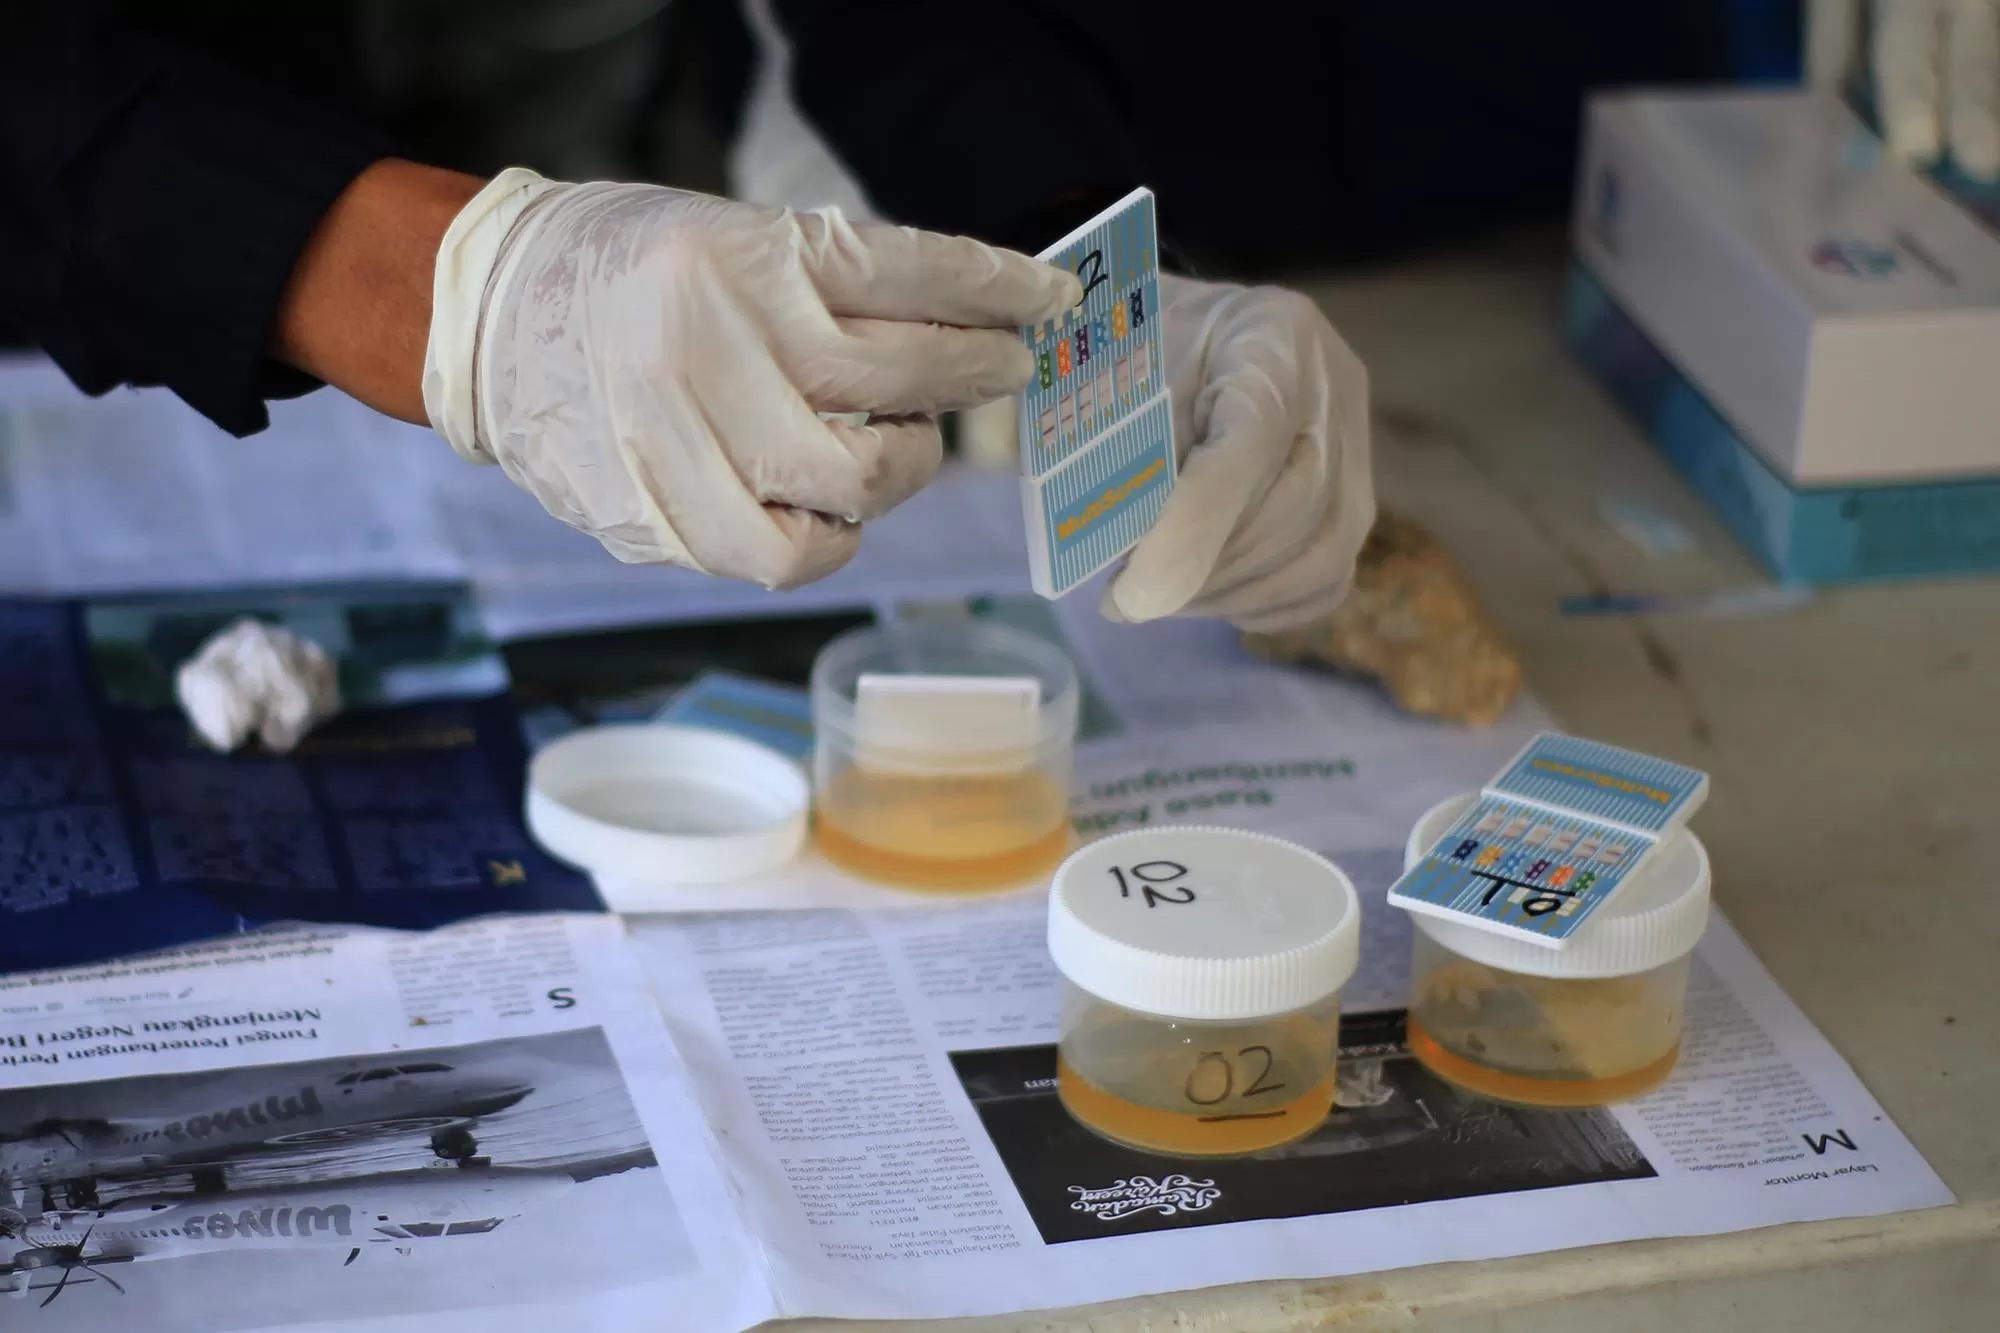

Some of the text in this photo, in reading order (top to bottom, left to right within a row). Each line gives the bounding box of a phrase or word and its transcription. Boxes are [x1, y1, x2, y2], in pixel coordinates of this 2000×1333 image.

[547, 987, 576, 1009] S
[143, 1008, 321, 1033] Menjangkau
[37, 1025, 135, 1046] Negeri
[236, 1028, 318, 1045] Fungsi
[67, 1037, 229, 1061] Penerbangan
[1184, 1045, 1286, 1105] 02
[1802, 1129, 1859, 1155] M
[1763, 1163, 1879, 1186] Layar Monitor
[1067, 1174, 1214, 1203] Kareem
[1070, 1187, 1221, 1221] Ramadan
[948, 1224, 1012, 1234] Kabupaten
